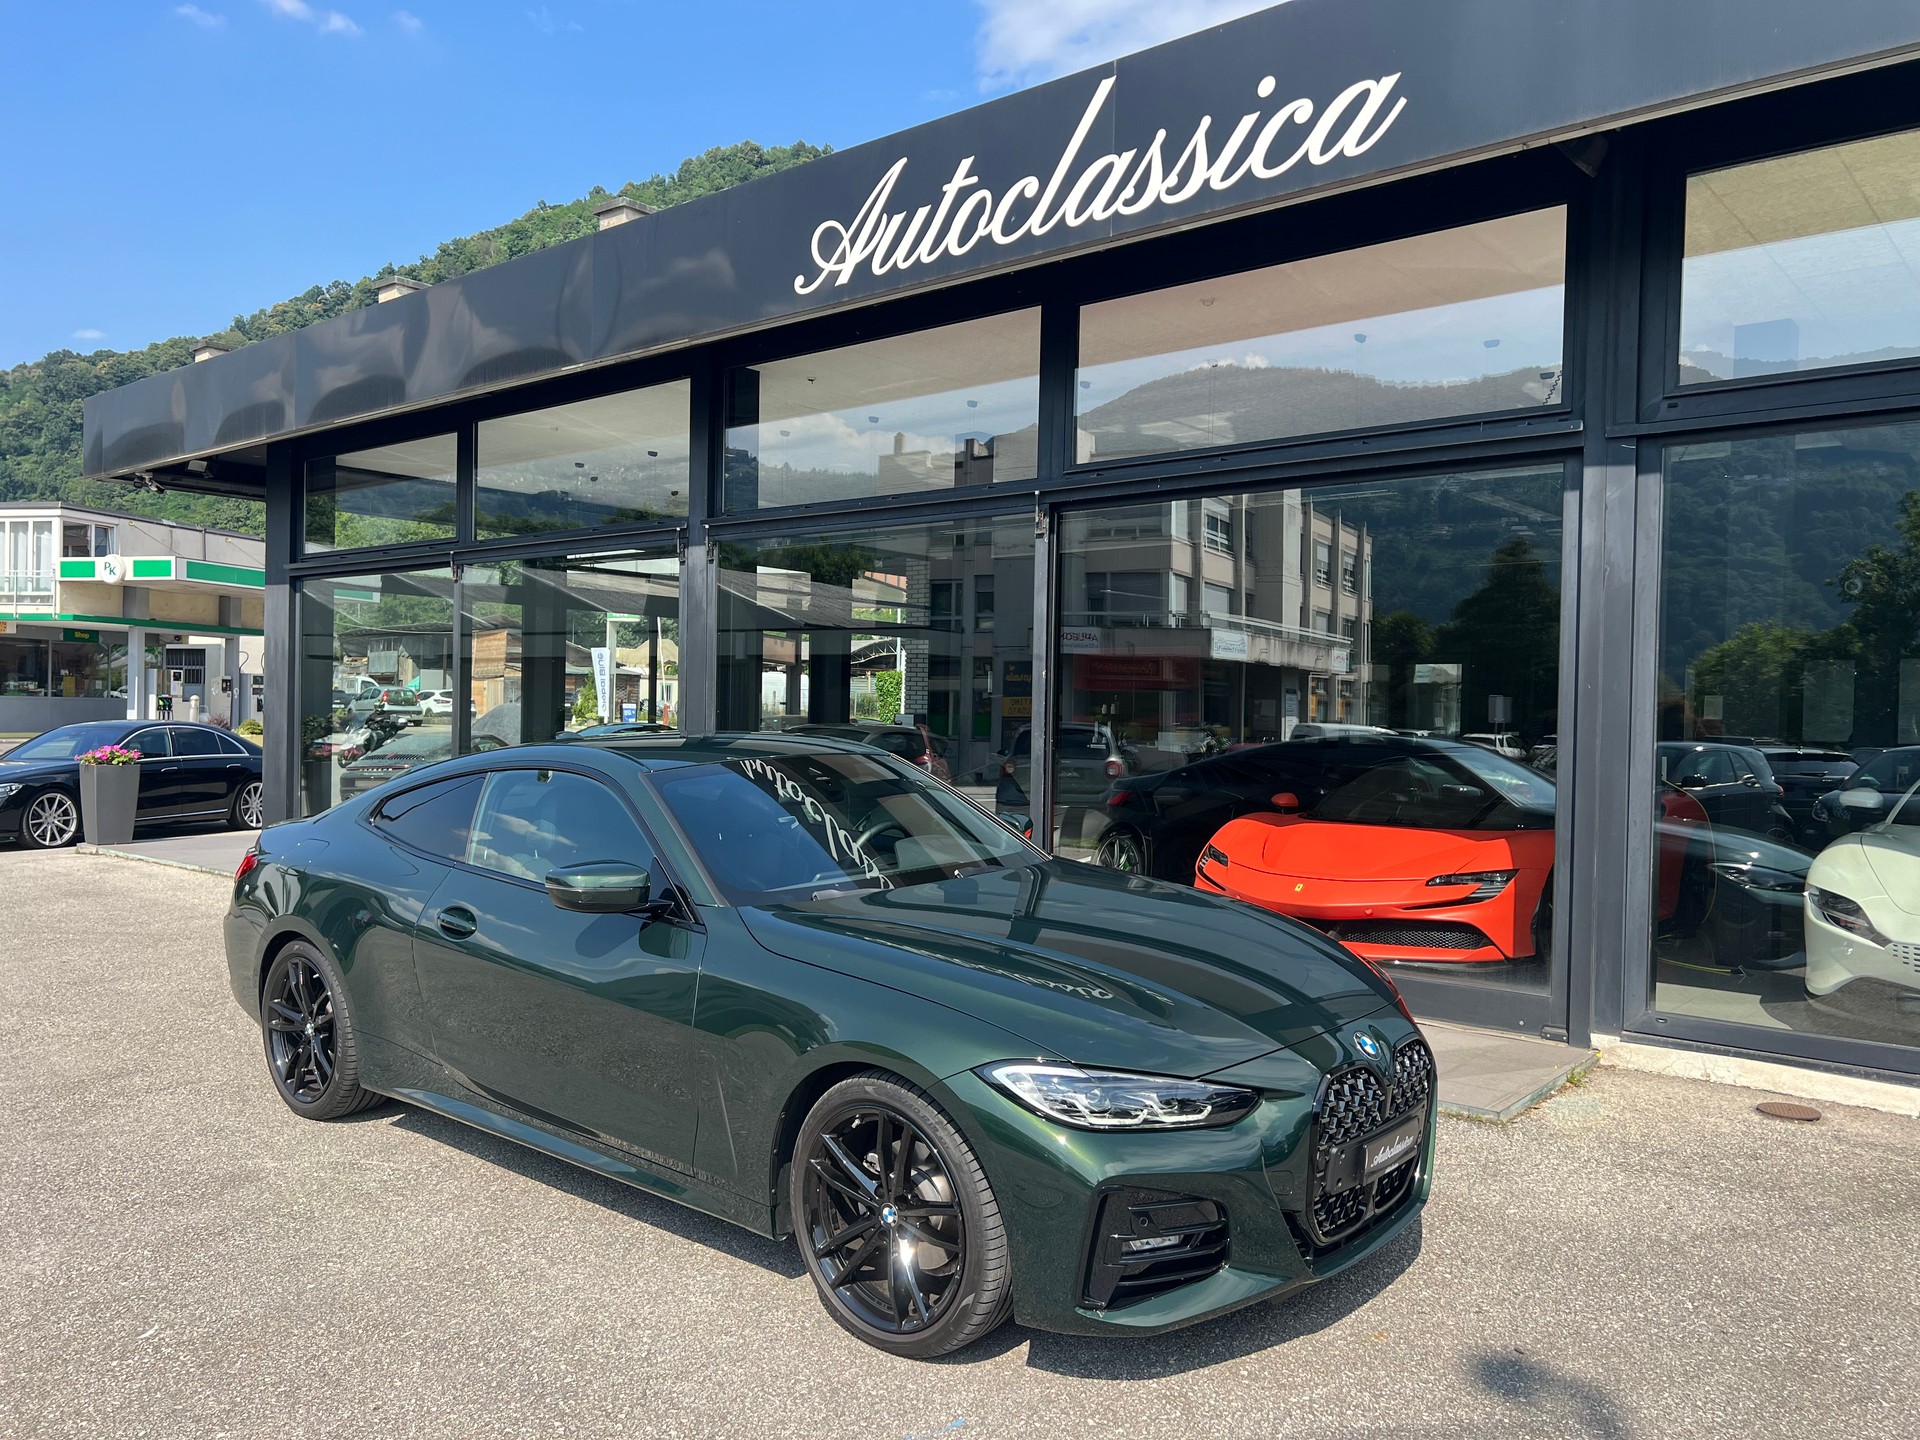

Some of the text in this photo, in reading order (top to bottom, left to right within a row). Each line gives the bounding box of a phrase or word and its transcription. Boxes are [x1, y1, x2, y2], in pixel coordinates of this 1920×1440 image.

[793, 72, 1407, 294] Autoclassica
[104, 562, 116, 576] PK
[74, 631, 90, 640] Shop
